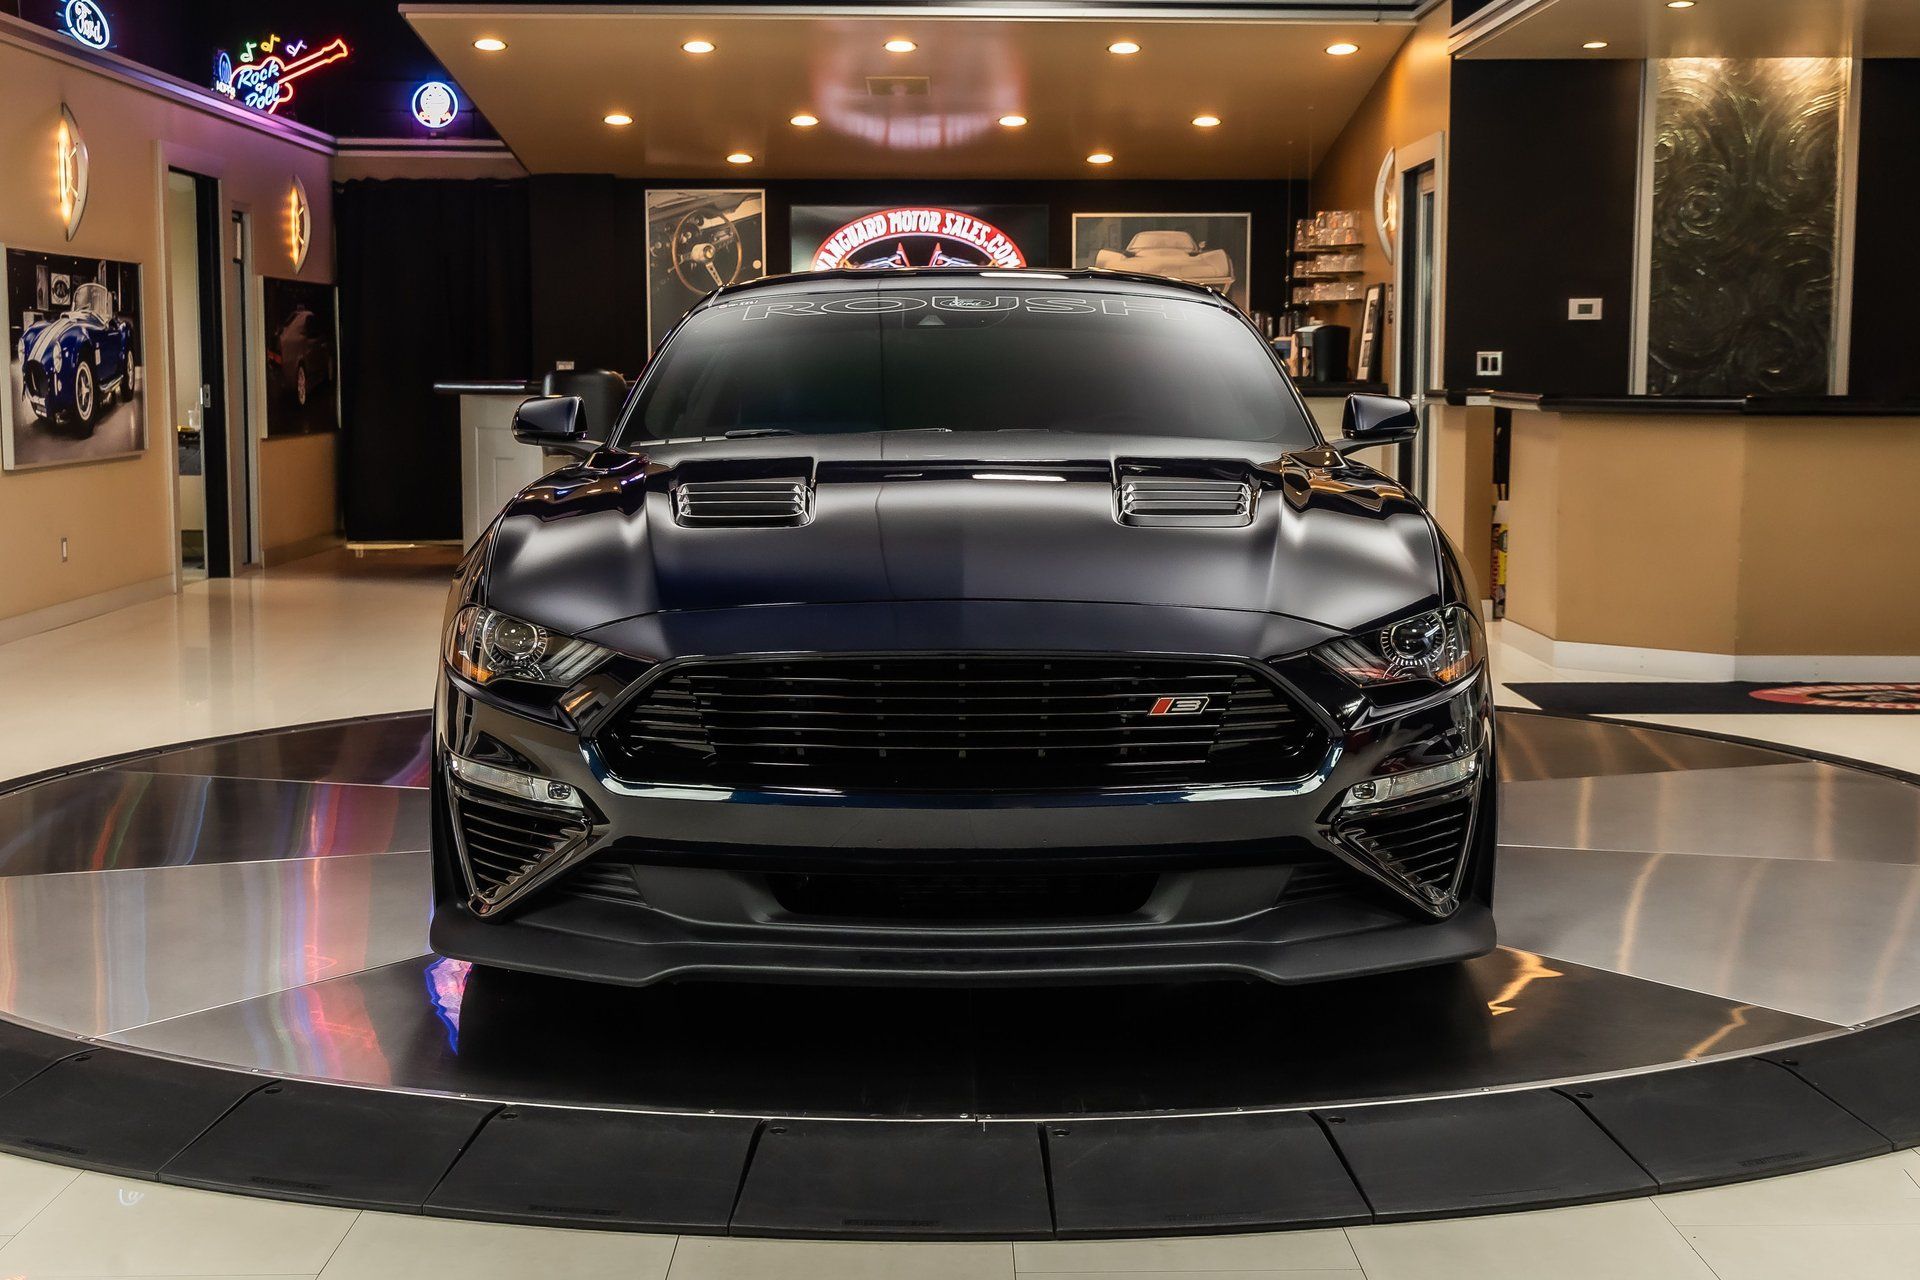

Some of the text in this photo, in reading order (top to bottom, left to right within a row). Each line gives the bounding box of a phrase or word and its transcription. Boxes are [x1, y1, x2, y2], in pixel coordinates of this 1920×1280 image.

[75, 1, 103, 43] Ford
[238, 60, 280, 90] Rock
[814, 214, 887, 271] VANGUARD
[888, 210, 941, 233] MOTOR
[743, 295, 1188, 321] ROUSH
